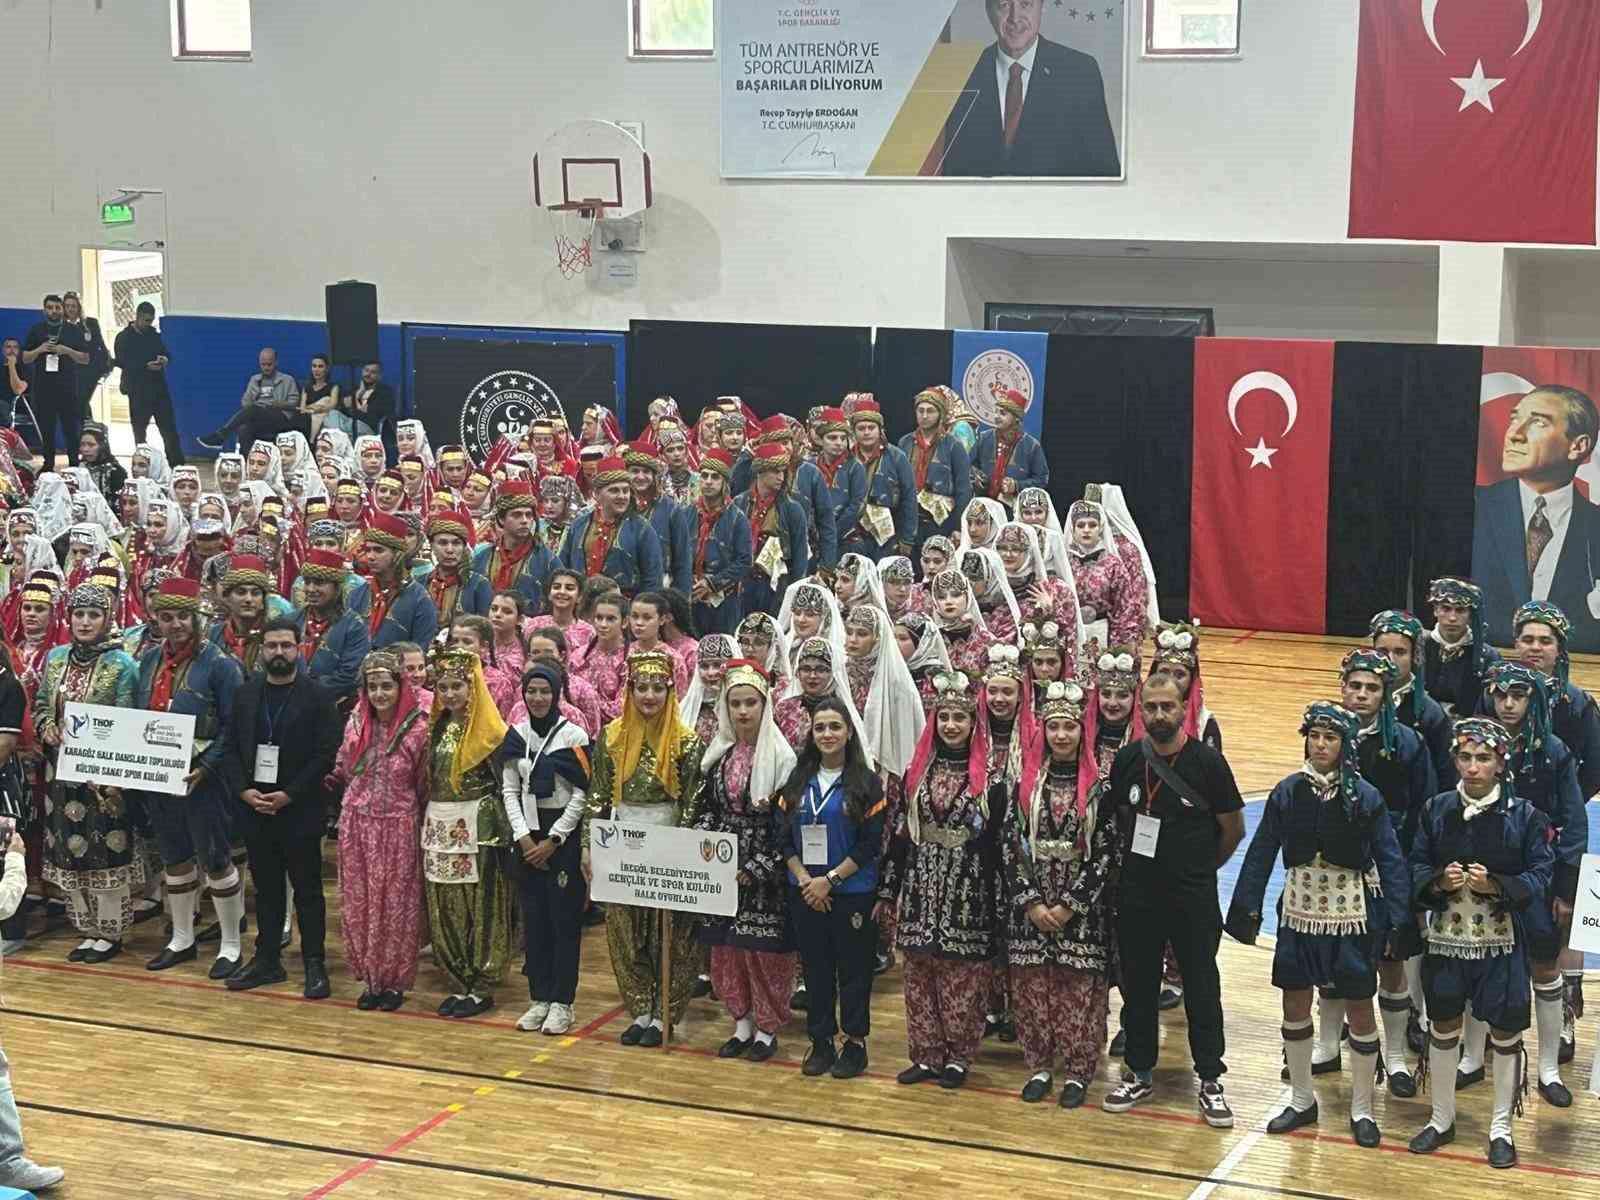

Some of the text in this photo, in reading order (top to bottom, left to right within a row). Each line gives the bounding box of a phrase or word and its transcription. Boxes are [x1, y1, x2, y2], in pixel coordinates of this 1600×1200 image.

[739, 40, 880, 58] TÜM ANTRENÖR VE
[744, 59, 875, 75] SPORCULARIMIZA
[736, 76, 883, 94] BAŞARILAR DİLİYORUM
[786, 108, 814, 119] Tayyip
[815, 106, 859, 117] ERDOĞAN
[762, 119, 856, 133] T.C. CUMHURBAŞKANI
[93, 718, 115, 728] THOF
[622, 828, 647, 839] THOF
[650, 866, 711, 881] BELEDİYESPOR
[608, 873, 722, 894] GENÇLİK VE SPOR KULÜBÜ
[634, 889, 657, 900] HALK
